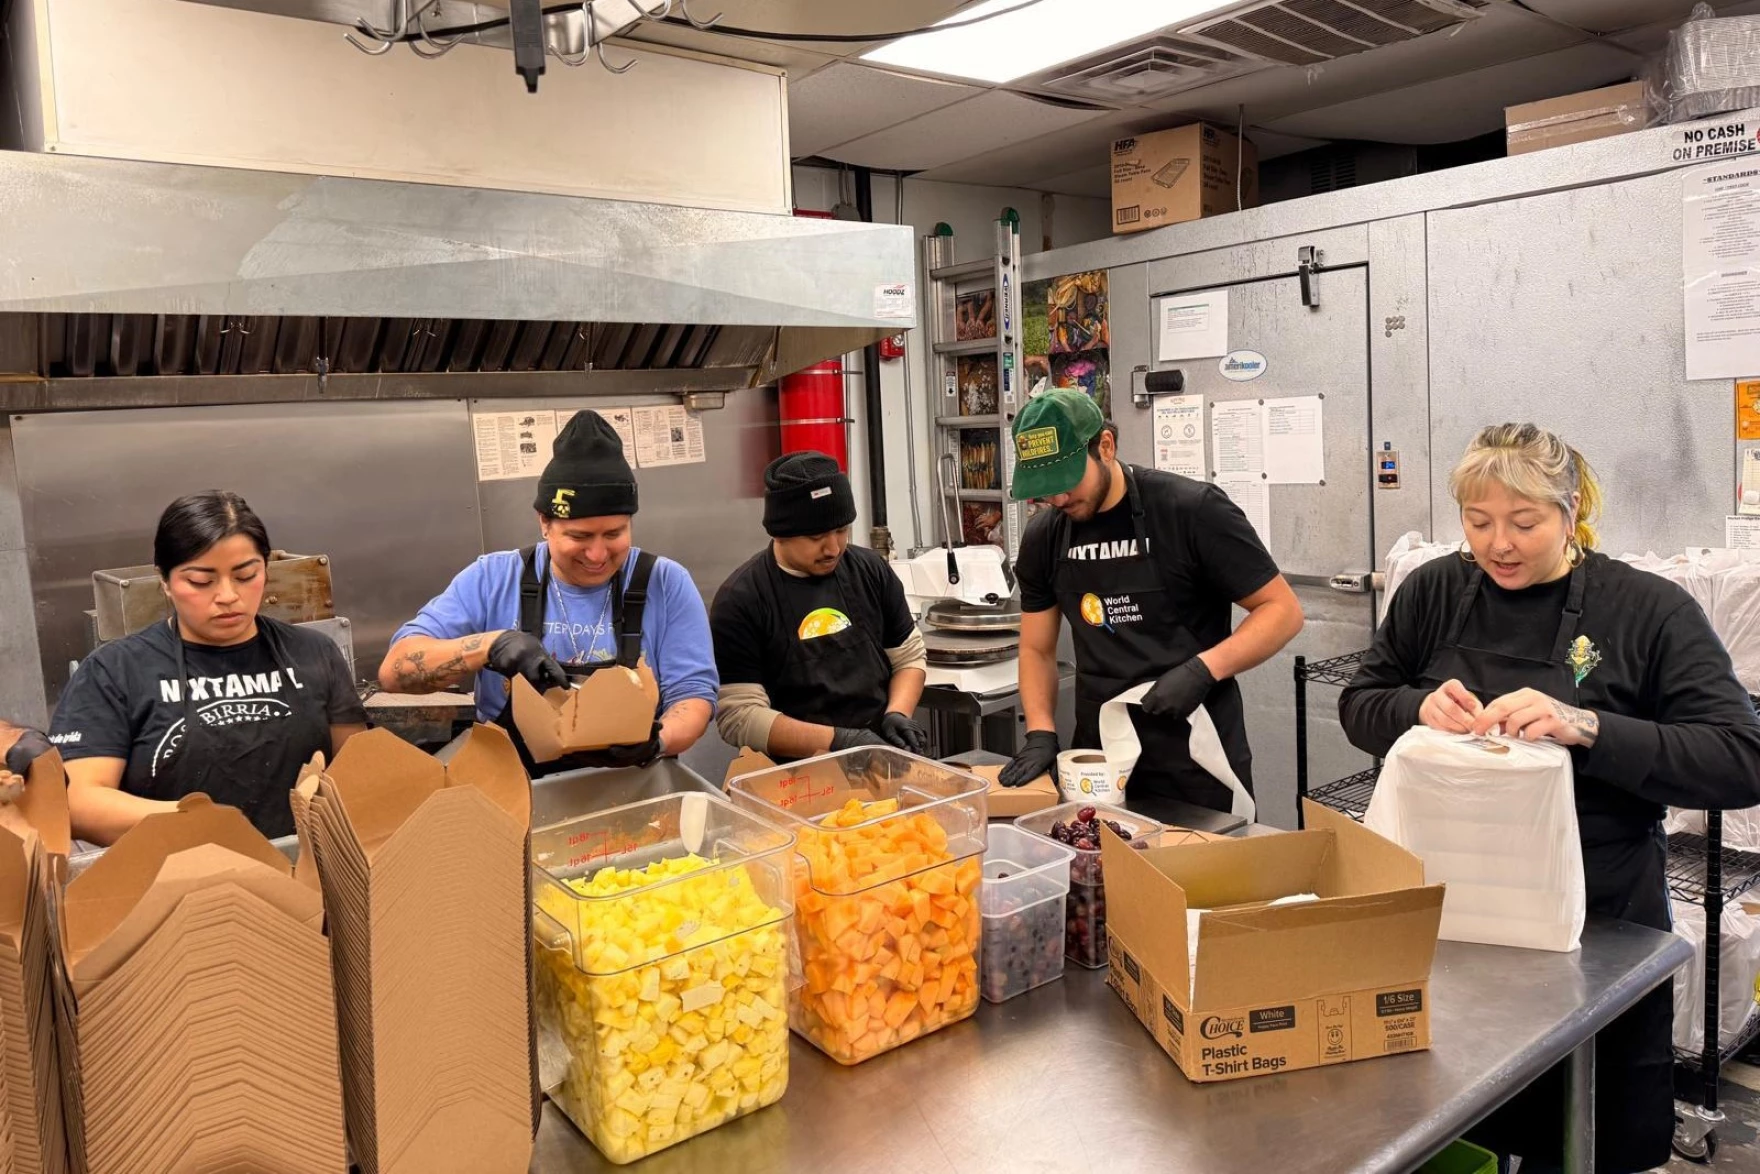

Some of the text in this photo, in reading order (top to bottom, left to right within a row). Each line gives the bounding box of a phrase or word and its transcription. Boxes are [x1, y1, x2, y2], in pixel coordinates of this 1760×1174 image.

[1684, 123, 1745, 143] NO CASH
[1114, 138, 1136, 151] HFA
[1673, 138, 1756, 160] ON PREMISE
[1707, 169, 1758, 183] STANDARDS
[1028, 436, 1054, 449] PREVENT
[1104, 595, 1130, 606] World
[1107, 604, 1139, 615] Central
[1109, 613, 1143, 624] Kitchen
[573, 623, 605, 636] DAYS
[160, 667, 303, 703] NXTAMAL
[200, 704, 271, 725] BIRRIA
[1397, 993, 1415, 1003] Size
[1260, 1009, 1285, 1020] White
[1200, 1016, 1245, 1040] CHOICE
[1201, 1044, 1247, 1060] Plastic
[1202, 1056, 1287, 1076] T-Shirt Bags
